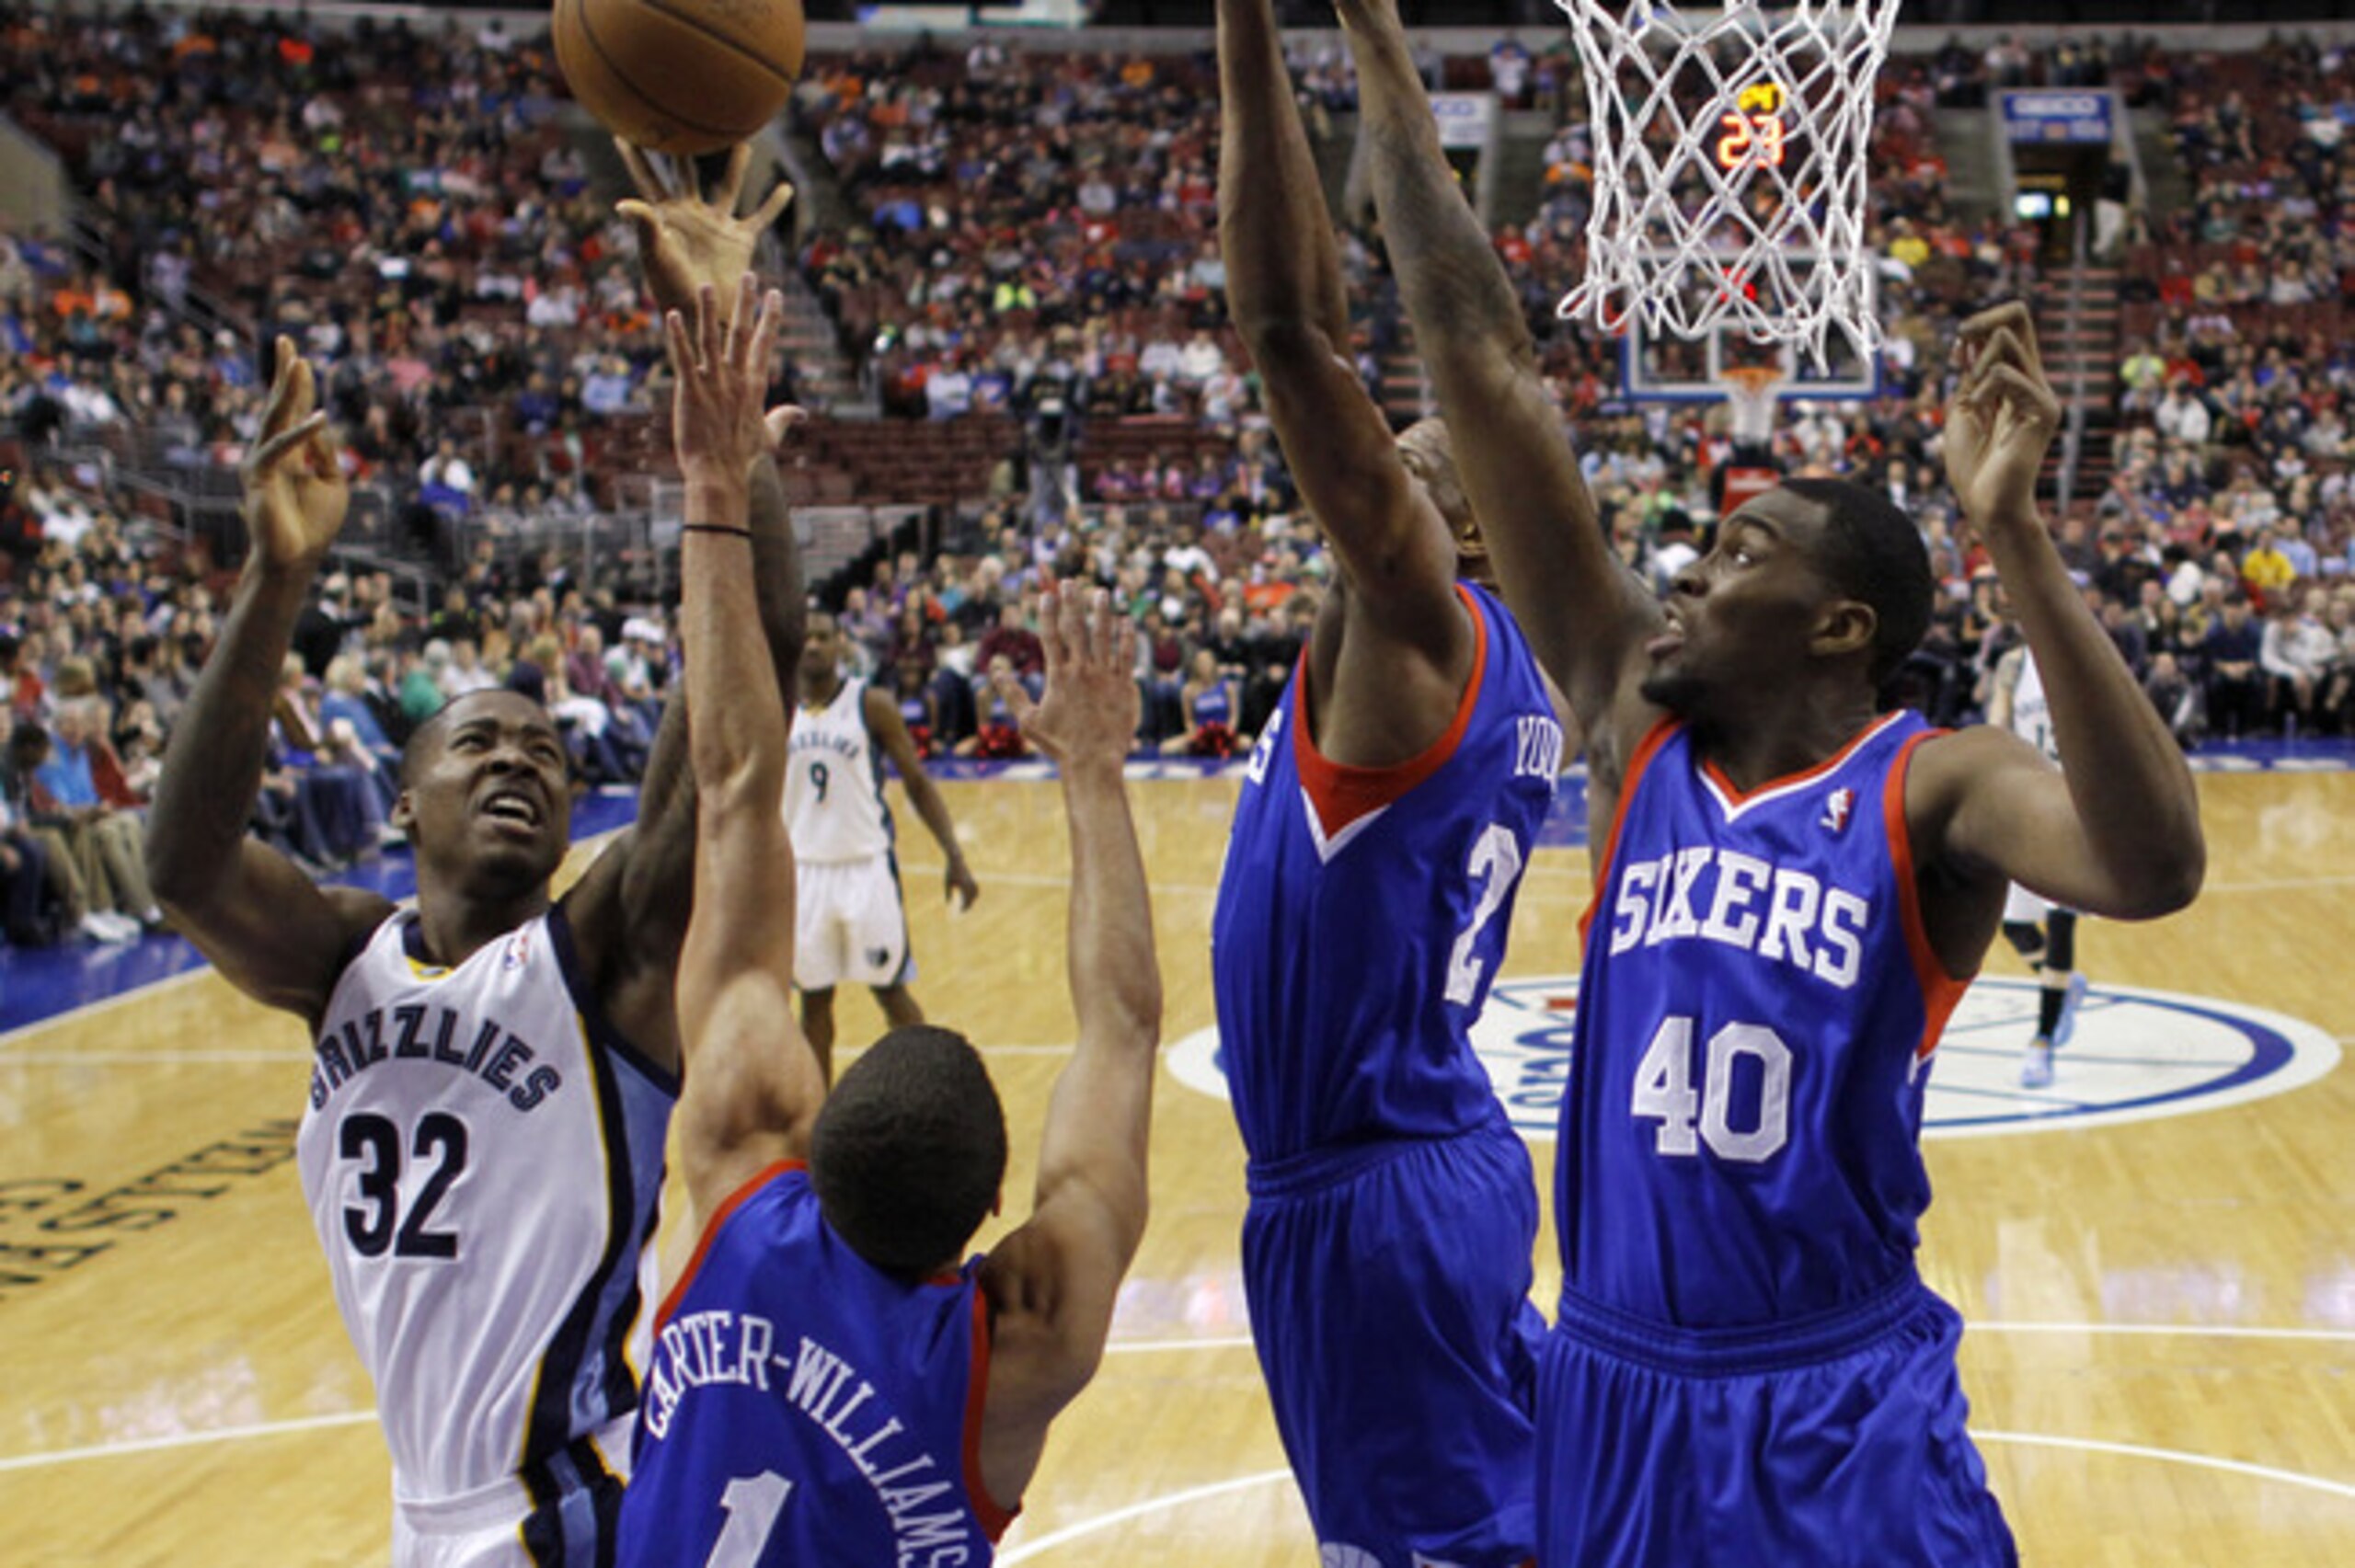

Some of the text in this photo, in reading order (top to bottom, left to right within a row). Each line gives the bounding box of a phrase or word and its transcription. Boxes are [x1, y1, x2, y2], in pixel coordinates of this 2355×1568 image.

[1717, 112, 1785, 169] 23
[810, 762, 828, 803] 9
[1443, 822, 1522, 1007] 2
[1609, 846, 1869, 989] SIXERS
[310, 1004, 562, 1111] GRIZZLIES
[1630, 1016, 1793, 1163] 40
[339, 1113, 467, 1257] 32
[705, 1469, 793, 1568] 1
